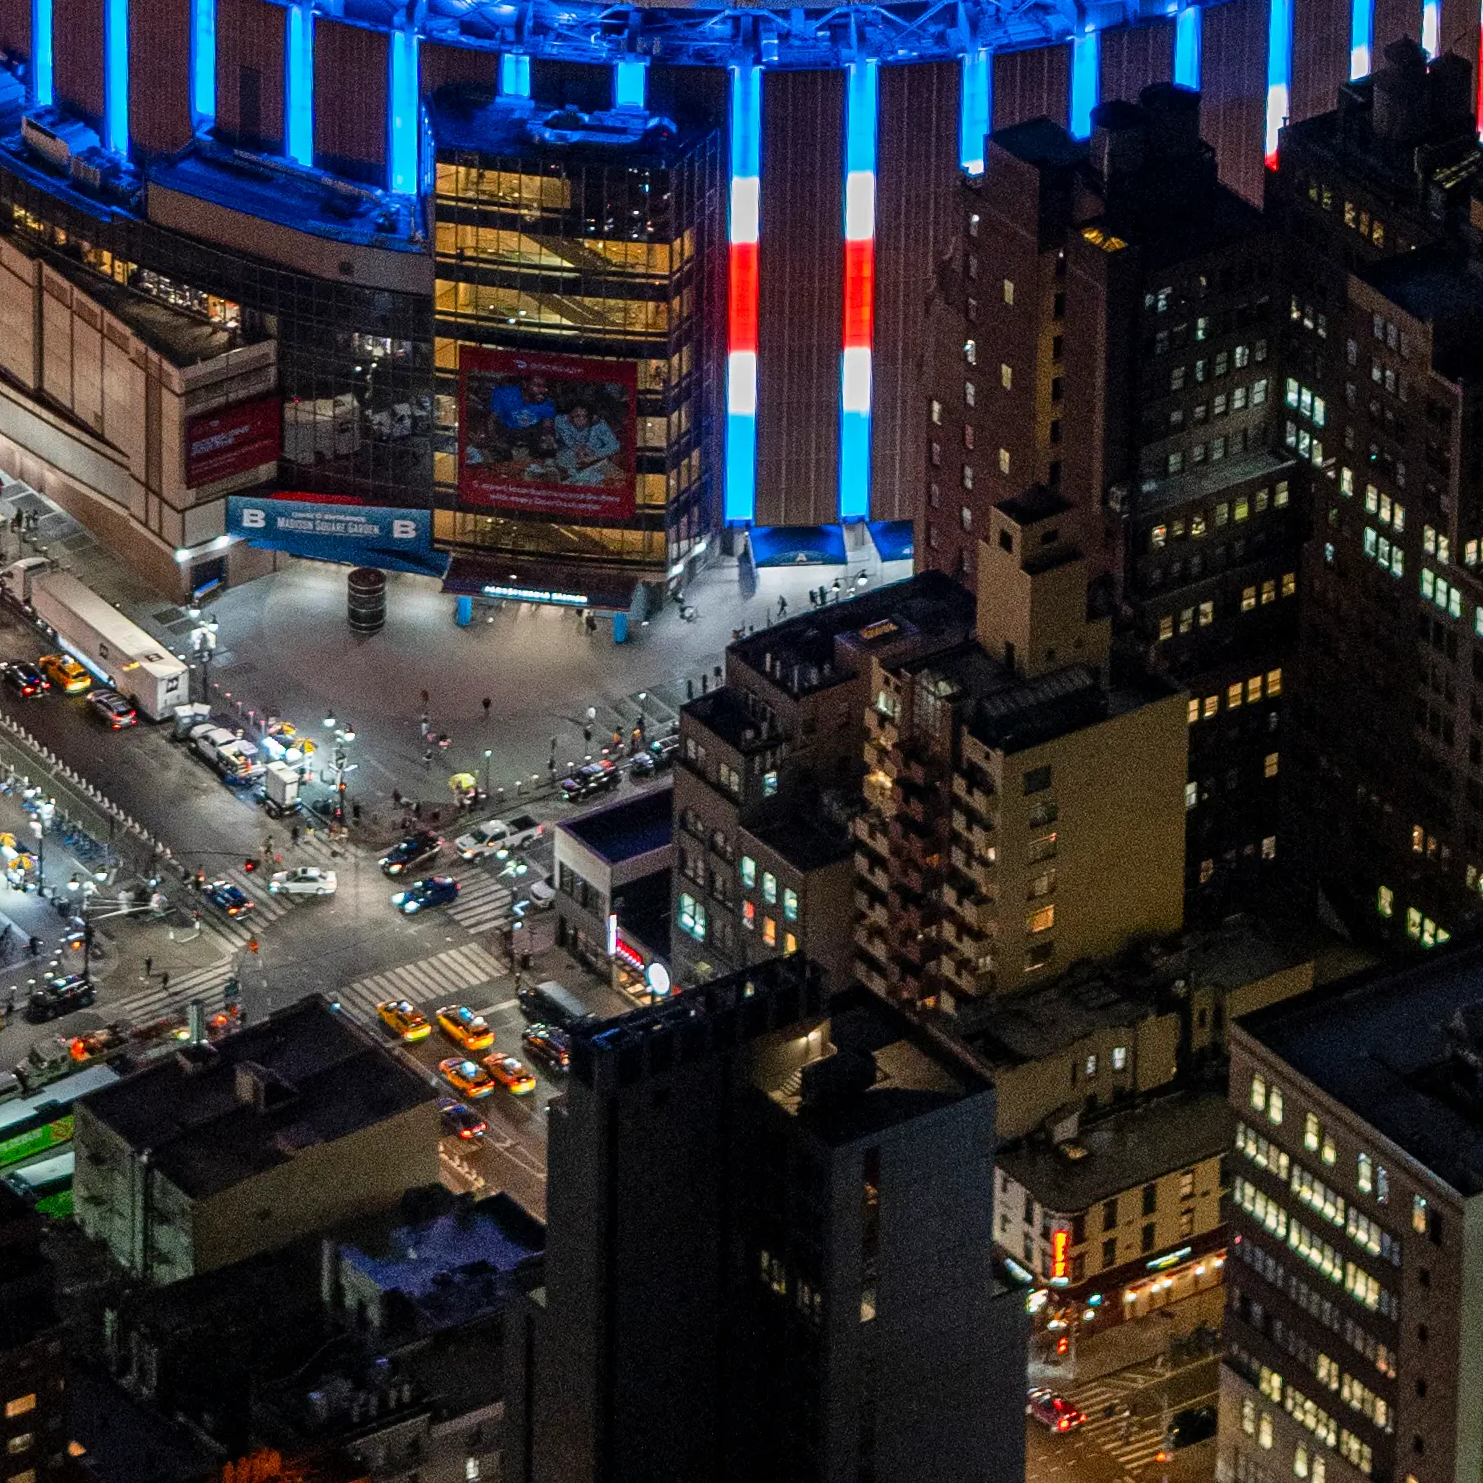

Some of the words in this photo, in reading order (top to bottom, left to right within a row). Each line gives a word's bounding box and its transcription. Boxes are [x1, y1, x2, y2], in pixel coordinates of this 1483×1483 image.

[242, 508, 265, 528] B
[277, 516, 314, 530] MADISON
[315, 520, 346, 533] SQUARE
[347, 521, 381, 535] GARDEN
[392, 520, 416, 539] B
[796, 552, 807, 562] A
